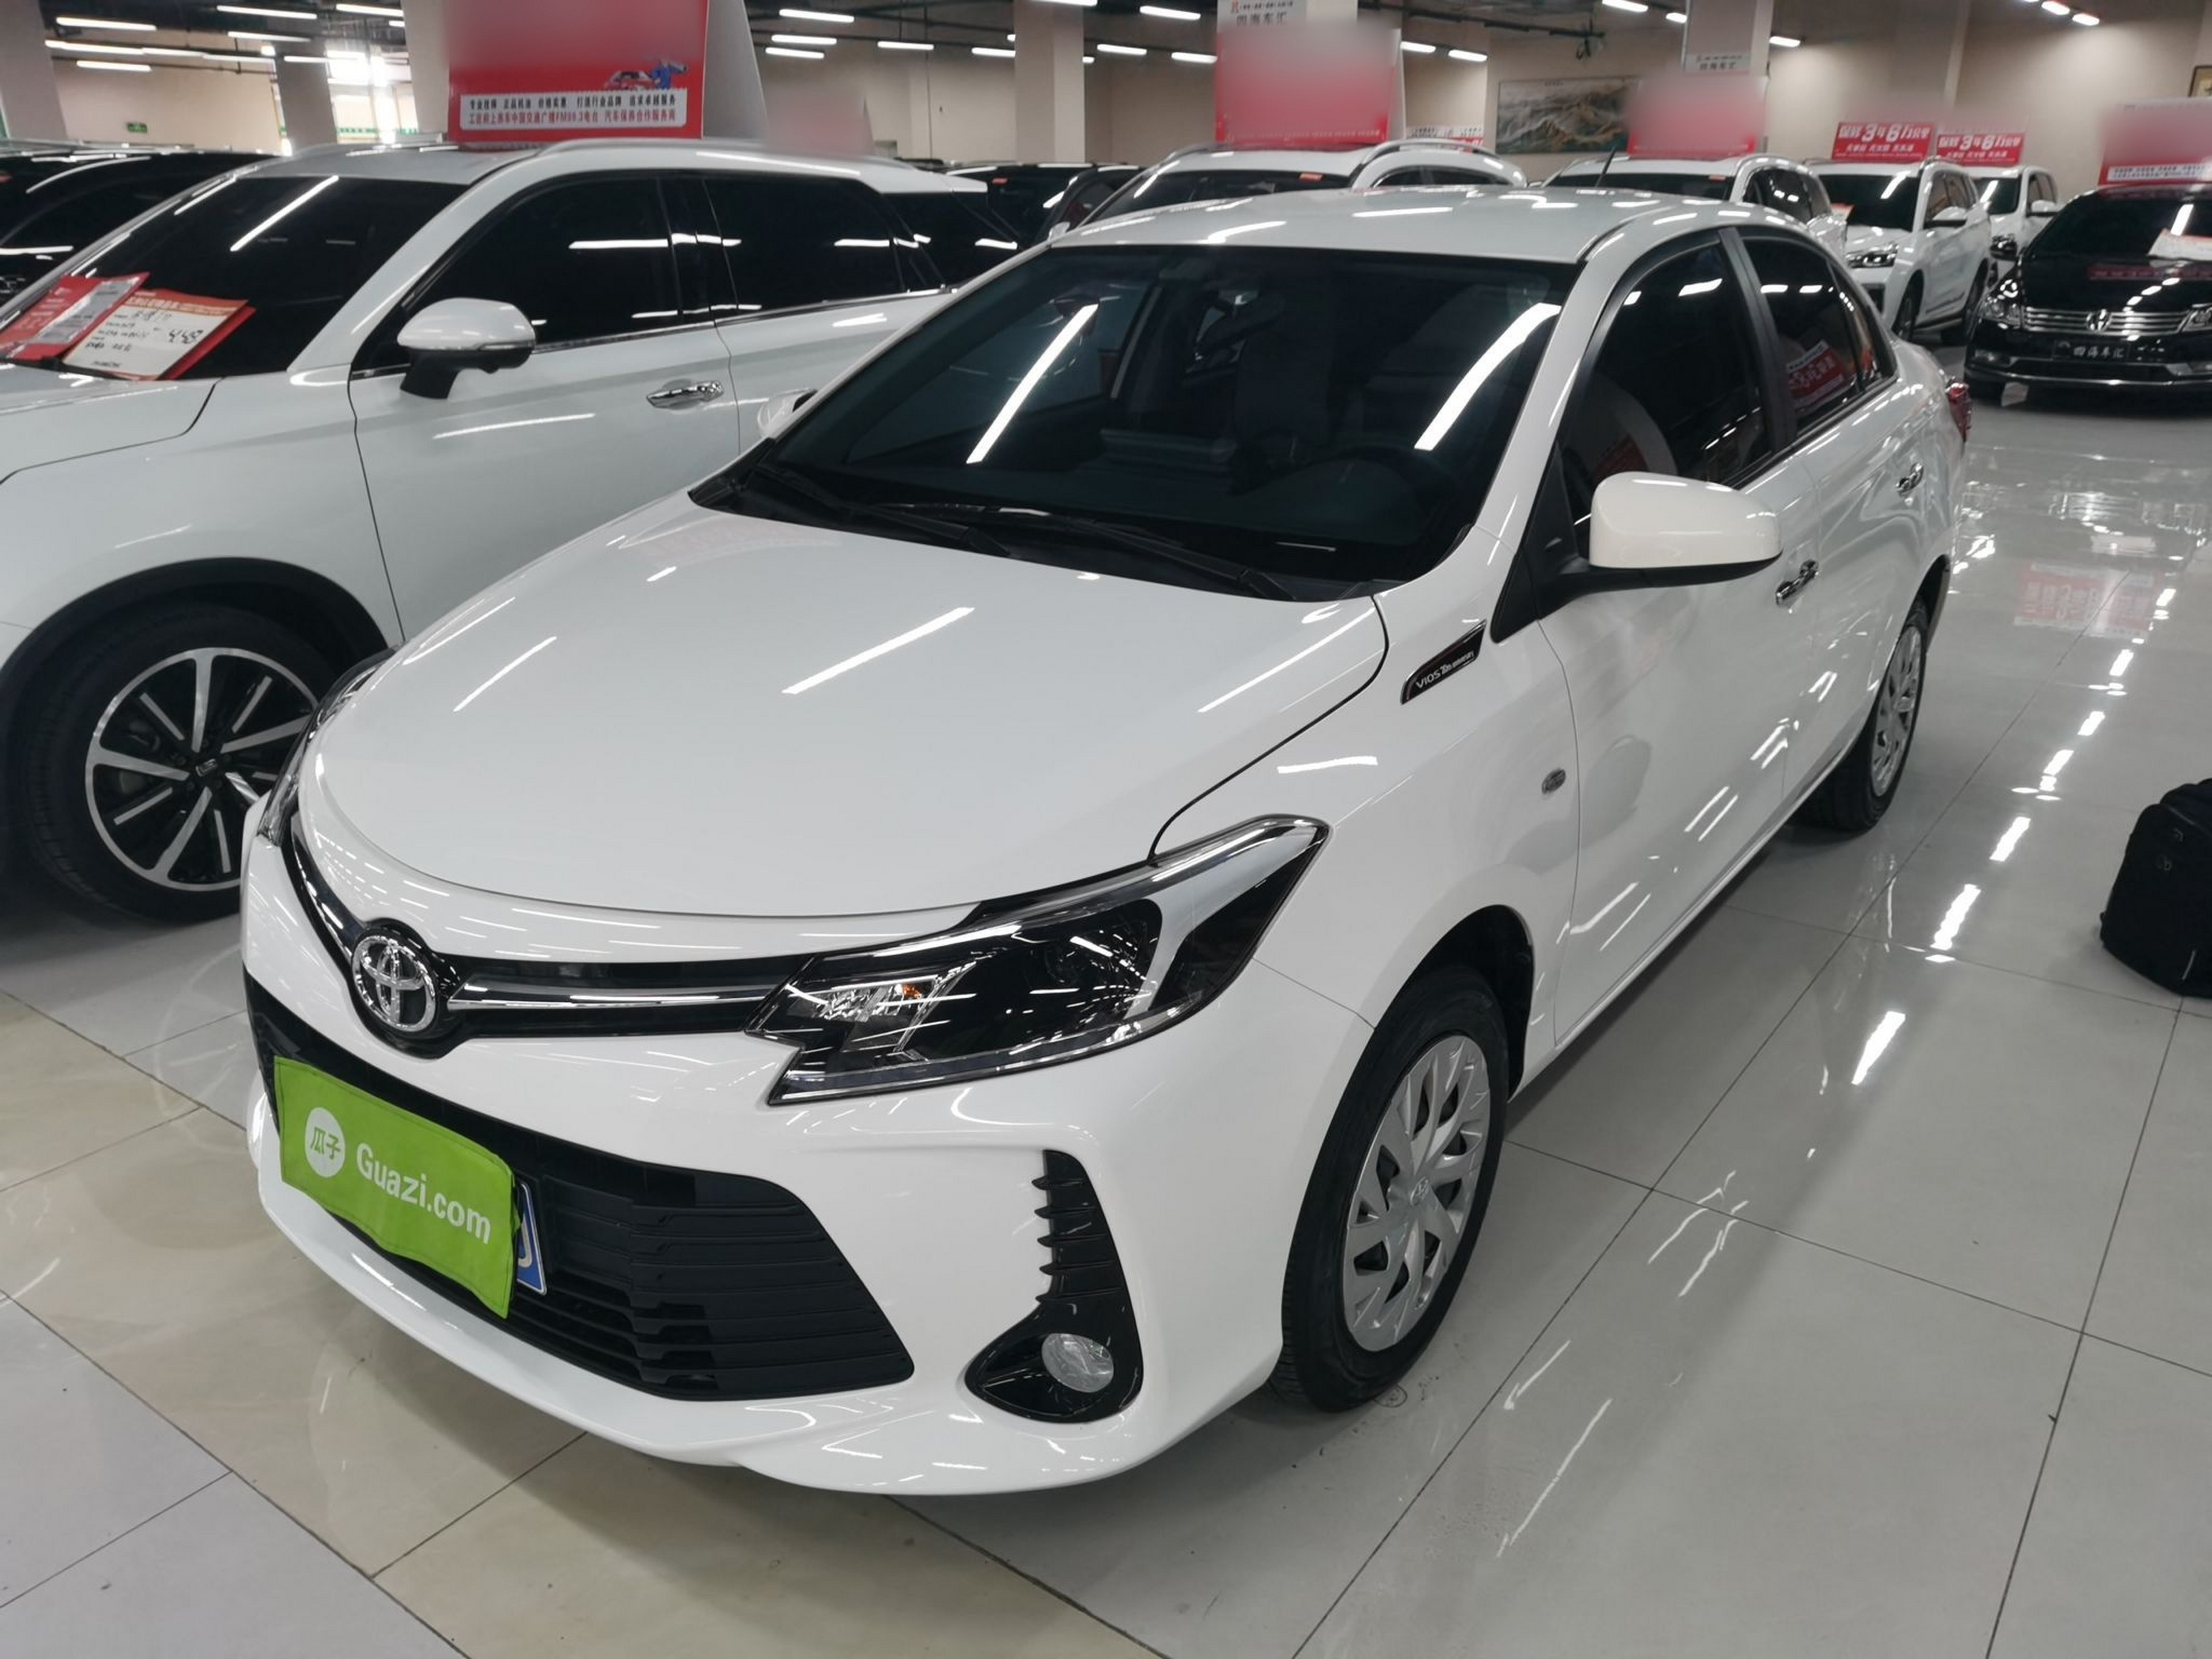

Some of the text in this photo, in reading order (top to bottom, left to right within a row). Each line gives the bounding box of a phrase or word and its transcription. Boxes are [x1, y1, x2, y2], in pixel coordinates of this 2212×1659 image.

[1415, 670, 1440, 688] VIOS
[310, 1126, 340, 1160] 瓜子
[356, 1142, 491, 1244] Guazi.com
